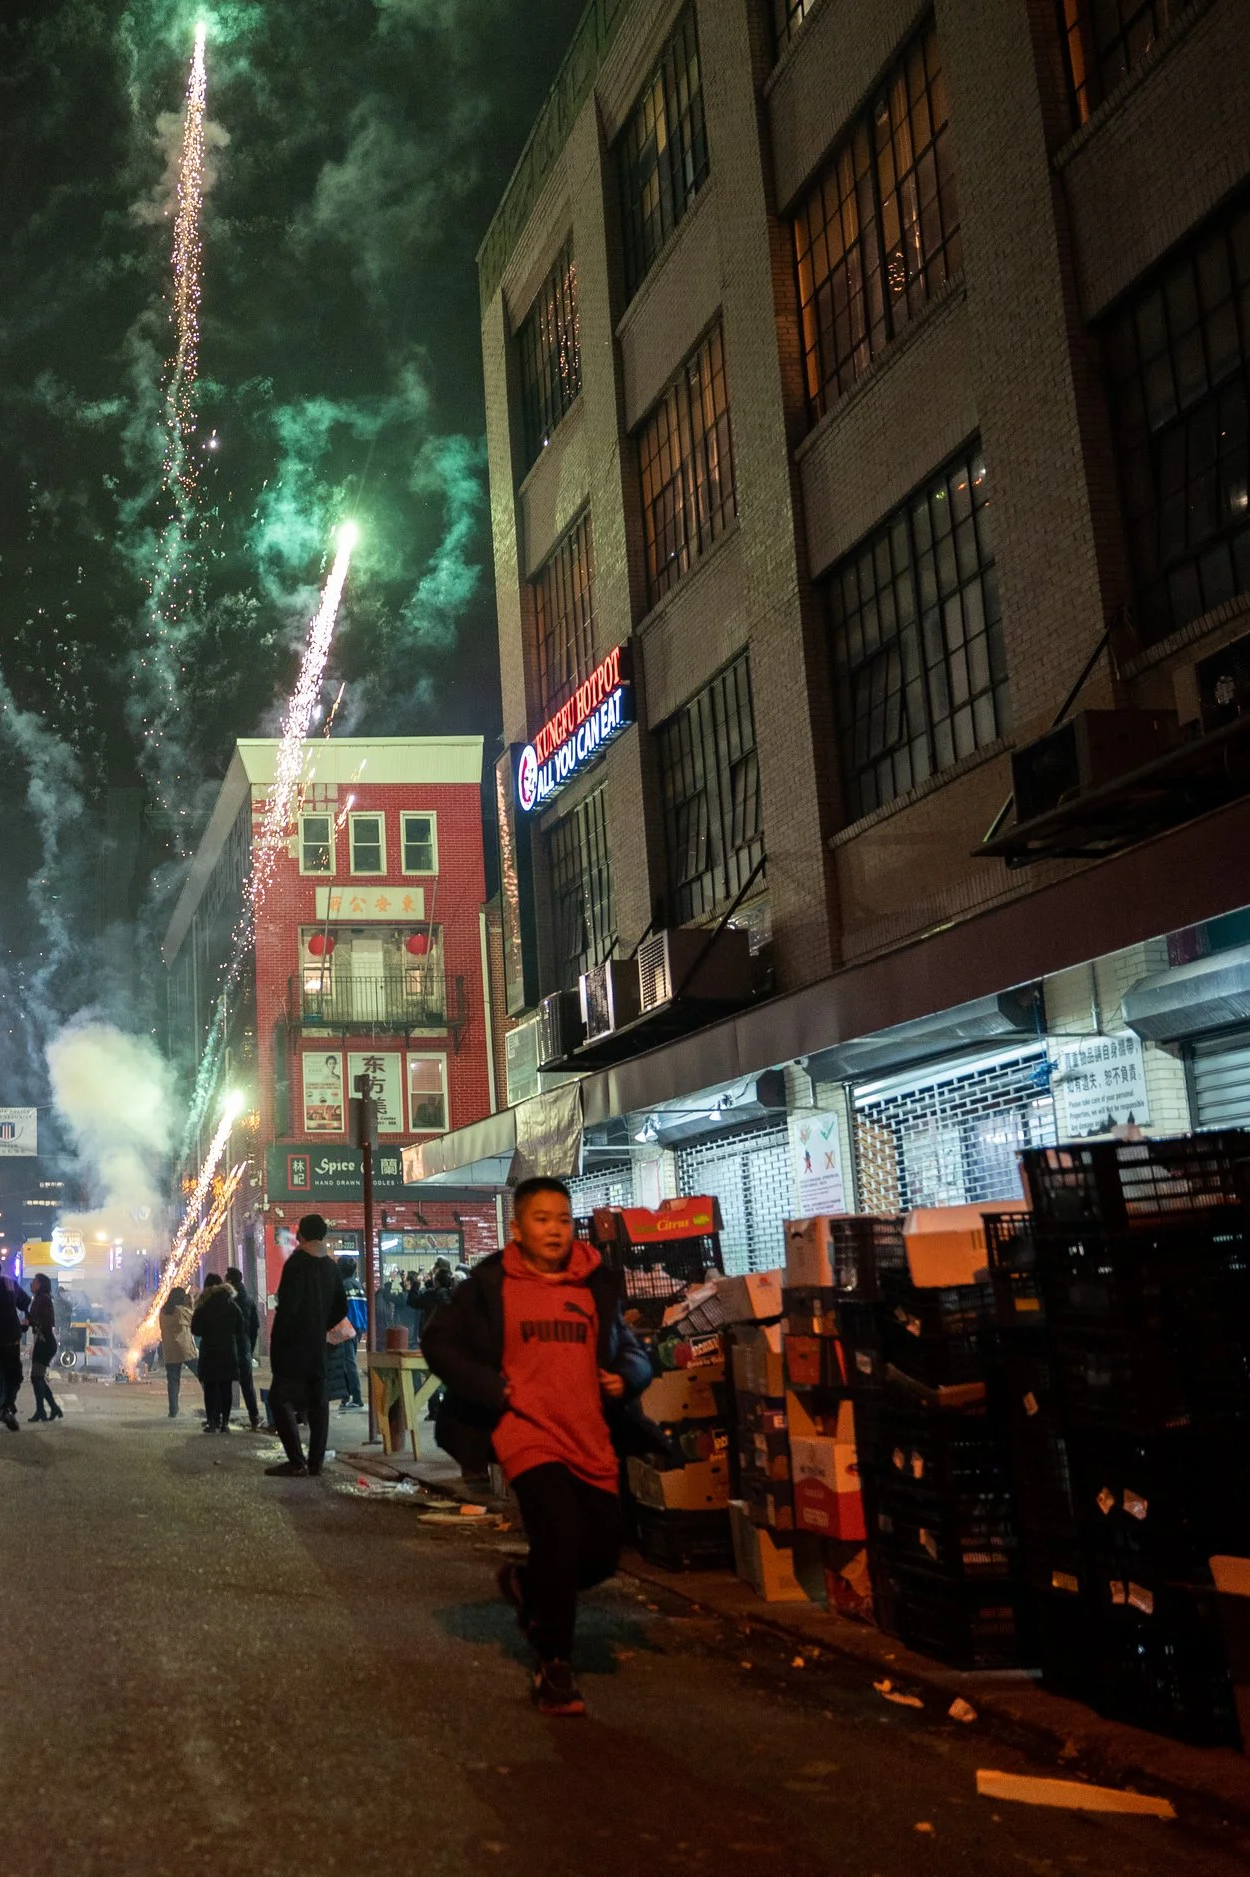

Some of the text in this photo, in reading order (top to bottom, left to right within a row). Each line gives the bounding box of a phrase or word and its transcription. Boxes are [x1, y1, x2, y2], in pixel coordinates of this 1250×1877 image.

[535, 646, 621, 764] KUNGFU HOTPOT
[537, 688, 622, 802] ALL YOU CAN EAT
[1069, 1100, 1081, 1108] Please
[1106, 1094, 1115, 1103] your
[1116, 1089, 1134, 1100] personal
[1120, 1099, 1144, 1110] responsible
[292, 1159, 305, 1185] 林記
[314, 1158, 355, 1175] Spice
[380, 1158, 402, 1175] 蘭
[657, 1217, 689, 1232] Citrus
[520, 1320, 588, 1344] PUMA
